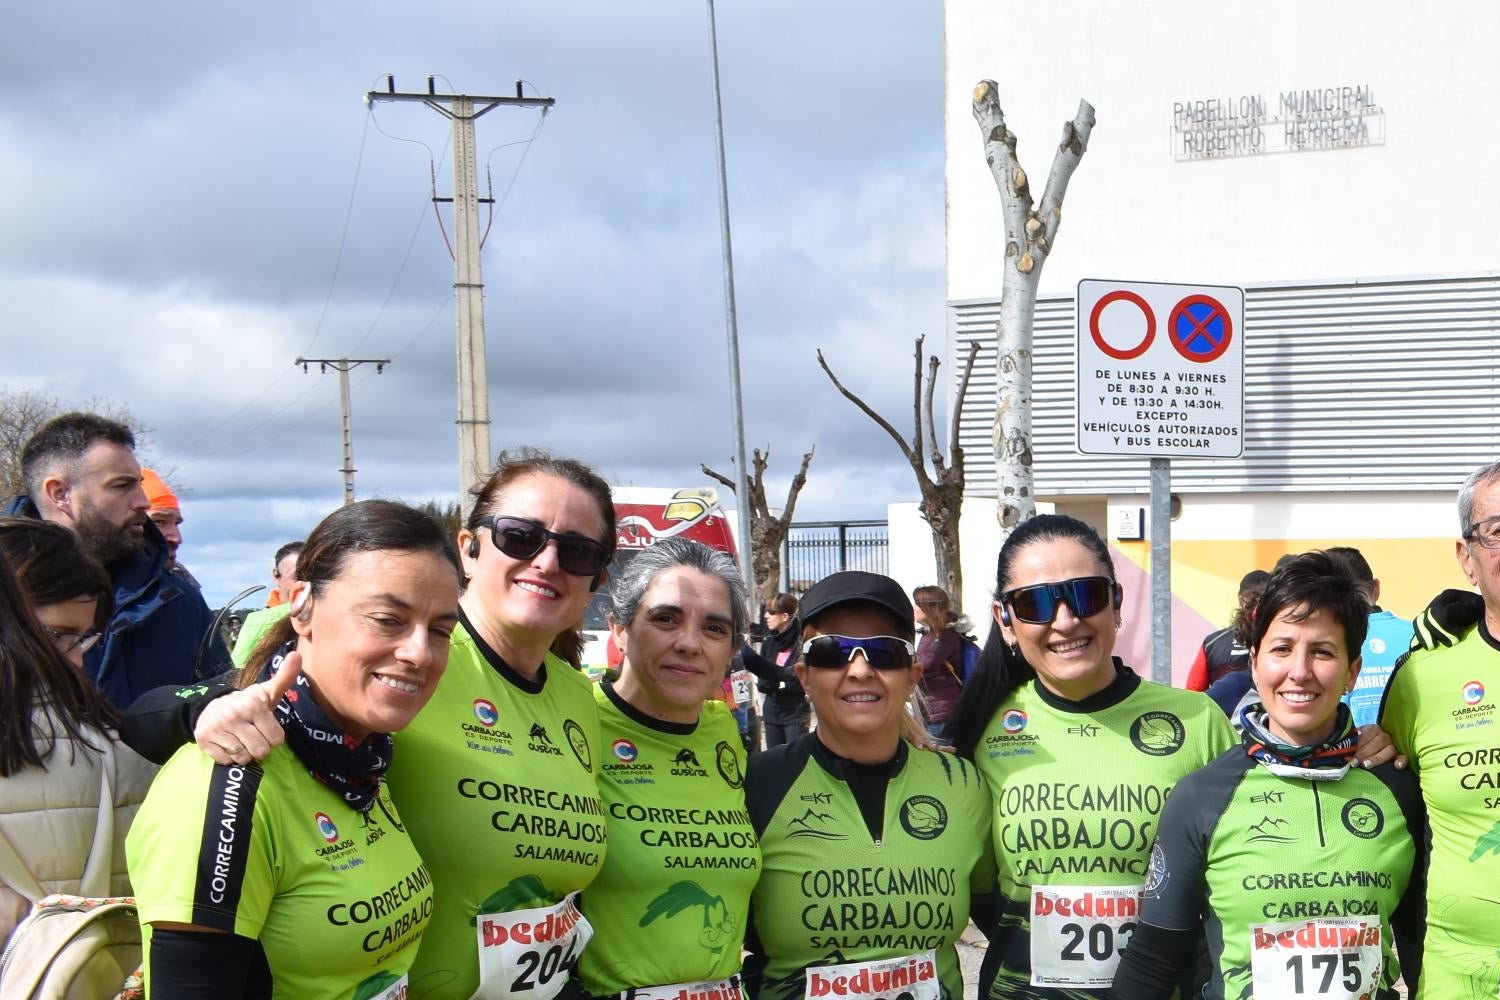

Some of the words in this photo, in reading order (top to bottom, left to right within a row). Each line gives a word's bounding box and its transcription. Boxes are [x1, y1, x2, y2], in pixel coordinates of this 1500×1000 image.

[1280, 85, 1376, 117] MUNICIPAL
[1183, 125, 1263, 154] ROBERTO
[1284, 117, 1369, 146] HERRERA
[1096, 370, 1111, 380] DE
[1117, 371, 1157, 381] LUNES
[1164, 372, 1171, 381] A
[1178, 373, 1227, 383] VIERNES
[1107, 384, 1123, 393] DE
[1129, 384, 1154, 394] 8:30
[1161, 385, 1168, 394] A
[1175, 386, 1199, 396] 9:30
[1205, 387, 1216, 397] H.
[1099, 397, 1106, 406] Y
[1112, 397, 1127, 407] DE
[1134, 398, 1164, 408] 13:30
[1170, 399, 1178, 408] A
[1184, 400, 1224, 410] 14:30H.
[1136, 411, 1188, 421] EXCEPTO
[1083, 421, 1151, 433] VEHÍCULOS
[1157, 426, 1238, 436] AUTORIZADOS
[1113, 437, 1120, 446] Y
[1127, 437, 1151, 447] BUS
[1157, 438, 1210, 448] ESCOLAR
[1452, 703, 1497, 717] CARBAJOSA
[461, 723, 513, 740] CARBAJOSA
[986, 734, 1040, 744] CARBAJOSA
[1002, 817, 1155, 854] CARBAJOS
[514, 844, 599, 867] SALAMANCA
[664, 855, 757, 870] SALAMANCA
[801, 866, 956, 898] CORRECAMINOS
[1242, 870, 1392, 891] CORRECAMINOS
[801, 901, 954, 931] CARBAJOSA
[1262, 899, 1378, 919] CARBAJOSA
[809, 934, 946, 950] SALAMANCA
[1253, 922, 1380, 951] bedunia
[810, 958, 935, 997] bedunia
[1286, 953, 1362, 994] 175
